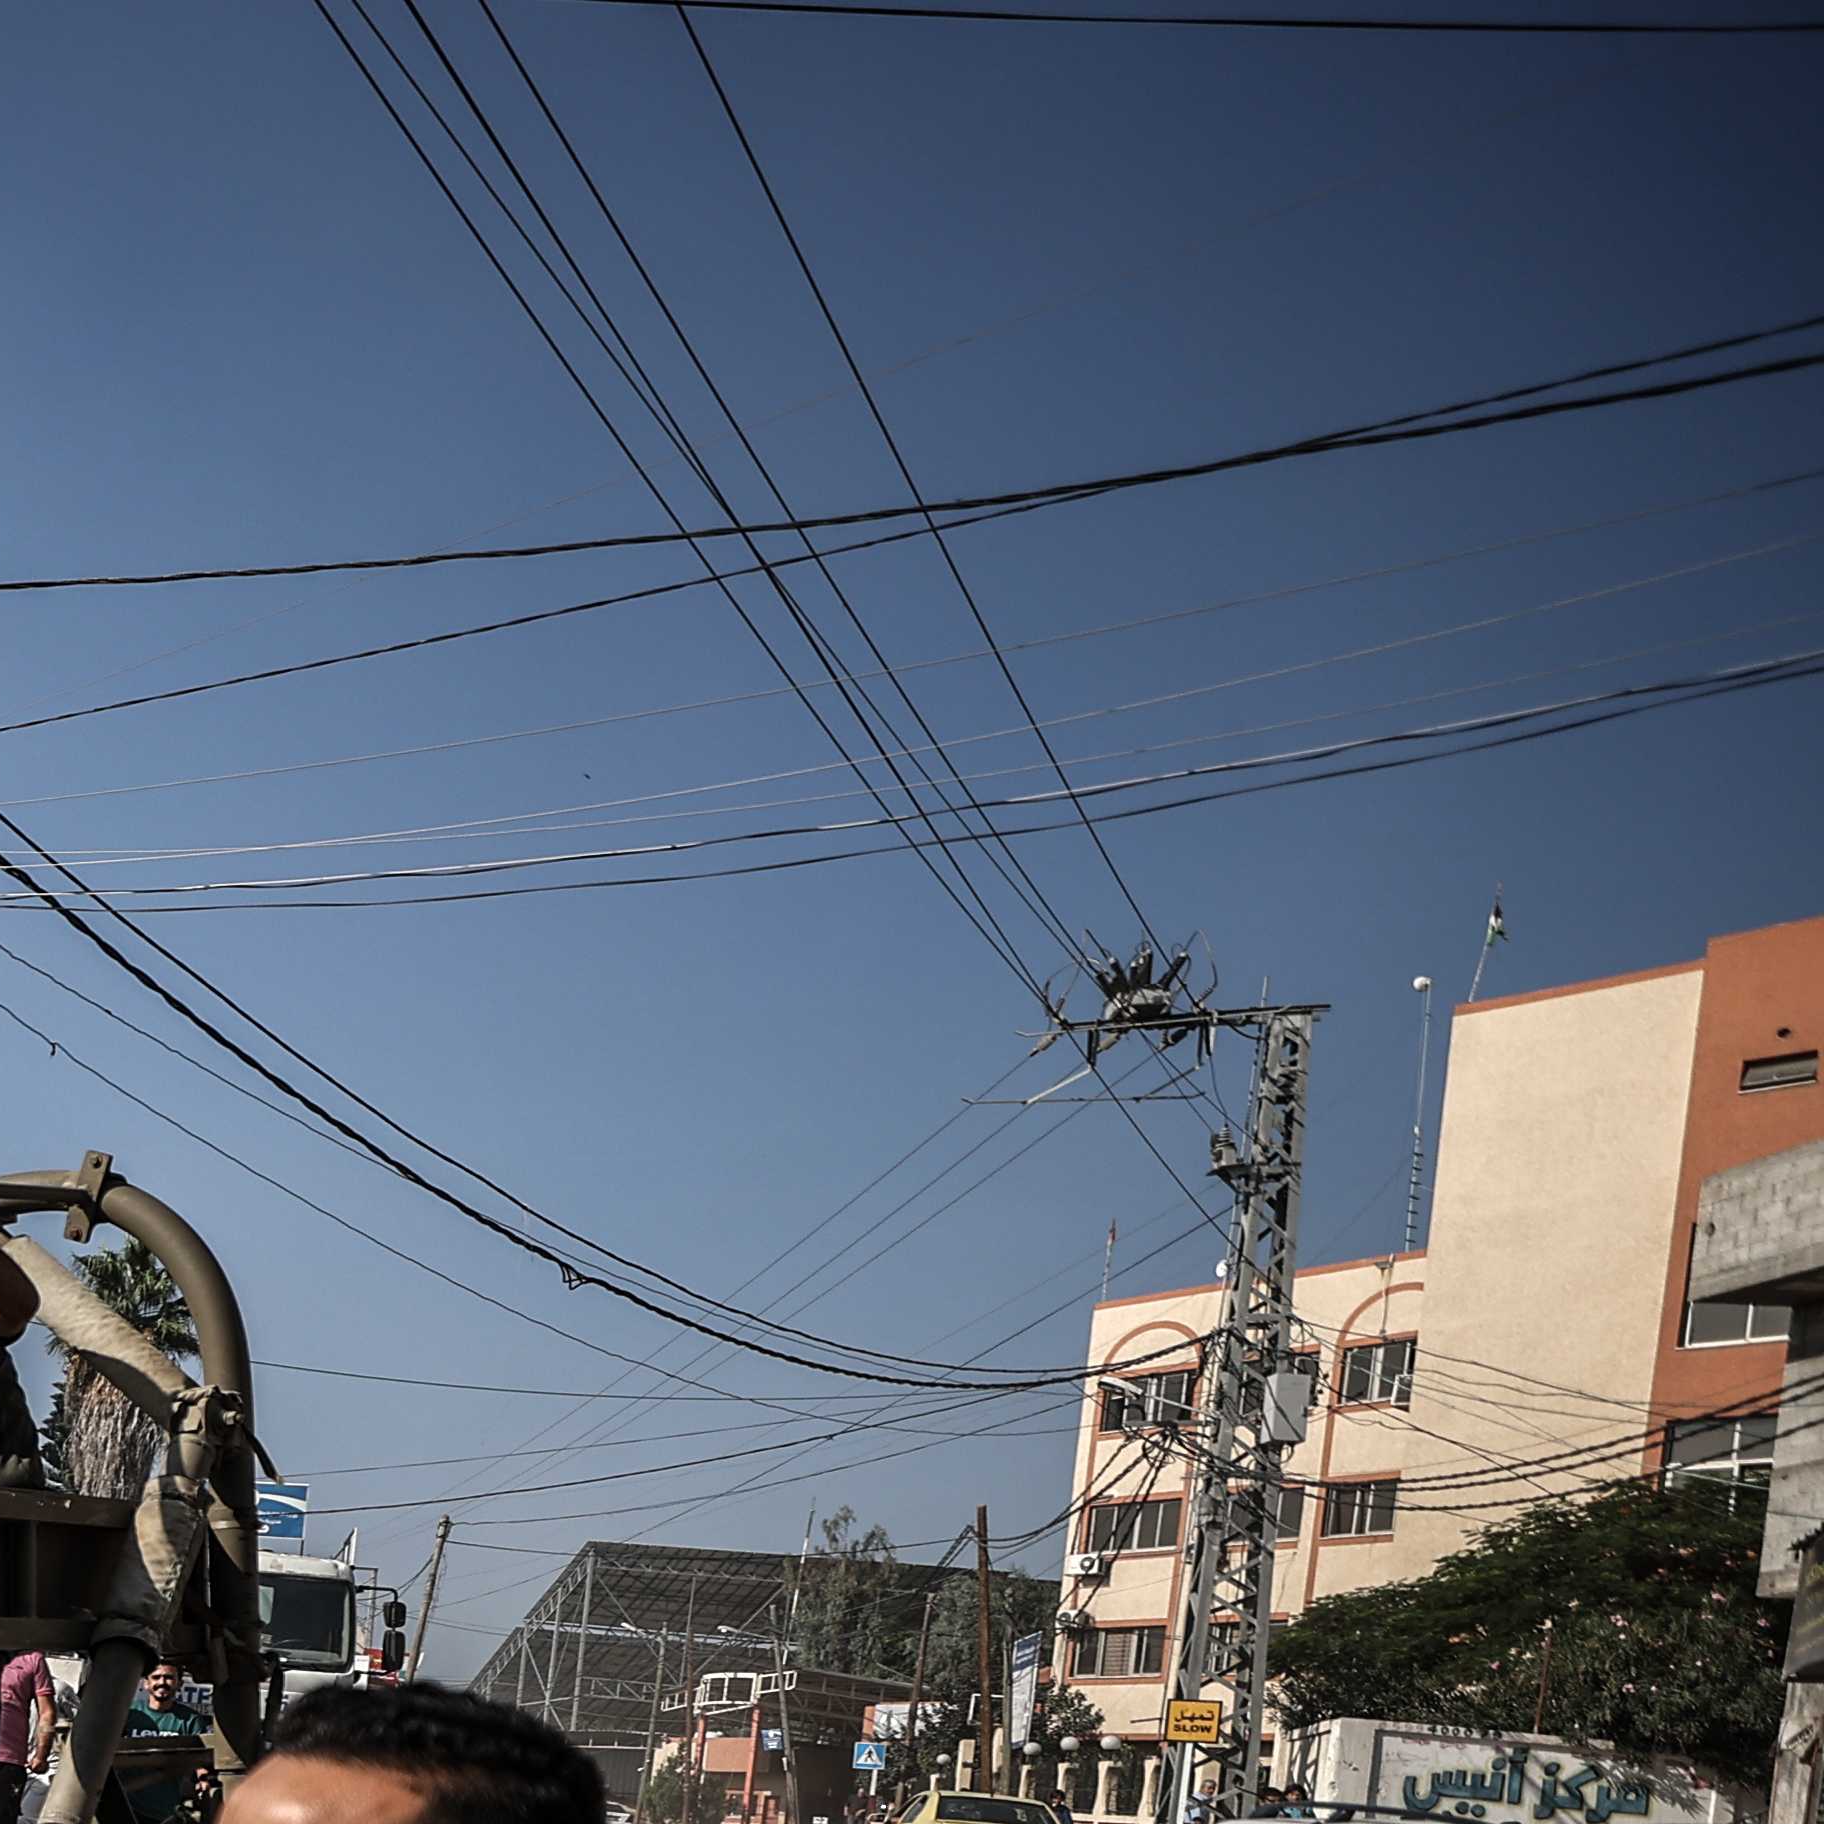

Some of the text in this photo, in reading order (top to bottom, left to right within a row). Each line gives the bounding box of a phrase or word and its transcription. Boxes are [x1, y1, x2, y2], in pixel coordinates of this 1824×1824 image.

[1174, 1709, 1215, 1723] تمهل
[1173, 1724, 1213, 1734] SLOW
[1402, 1745, 1650, 1824] مركز أنيس
